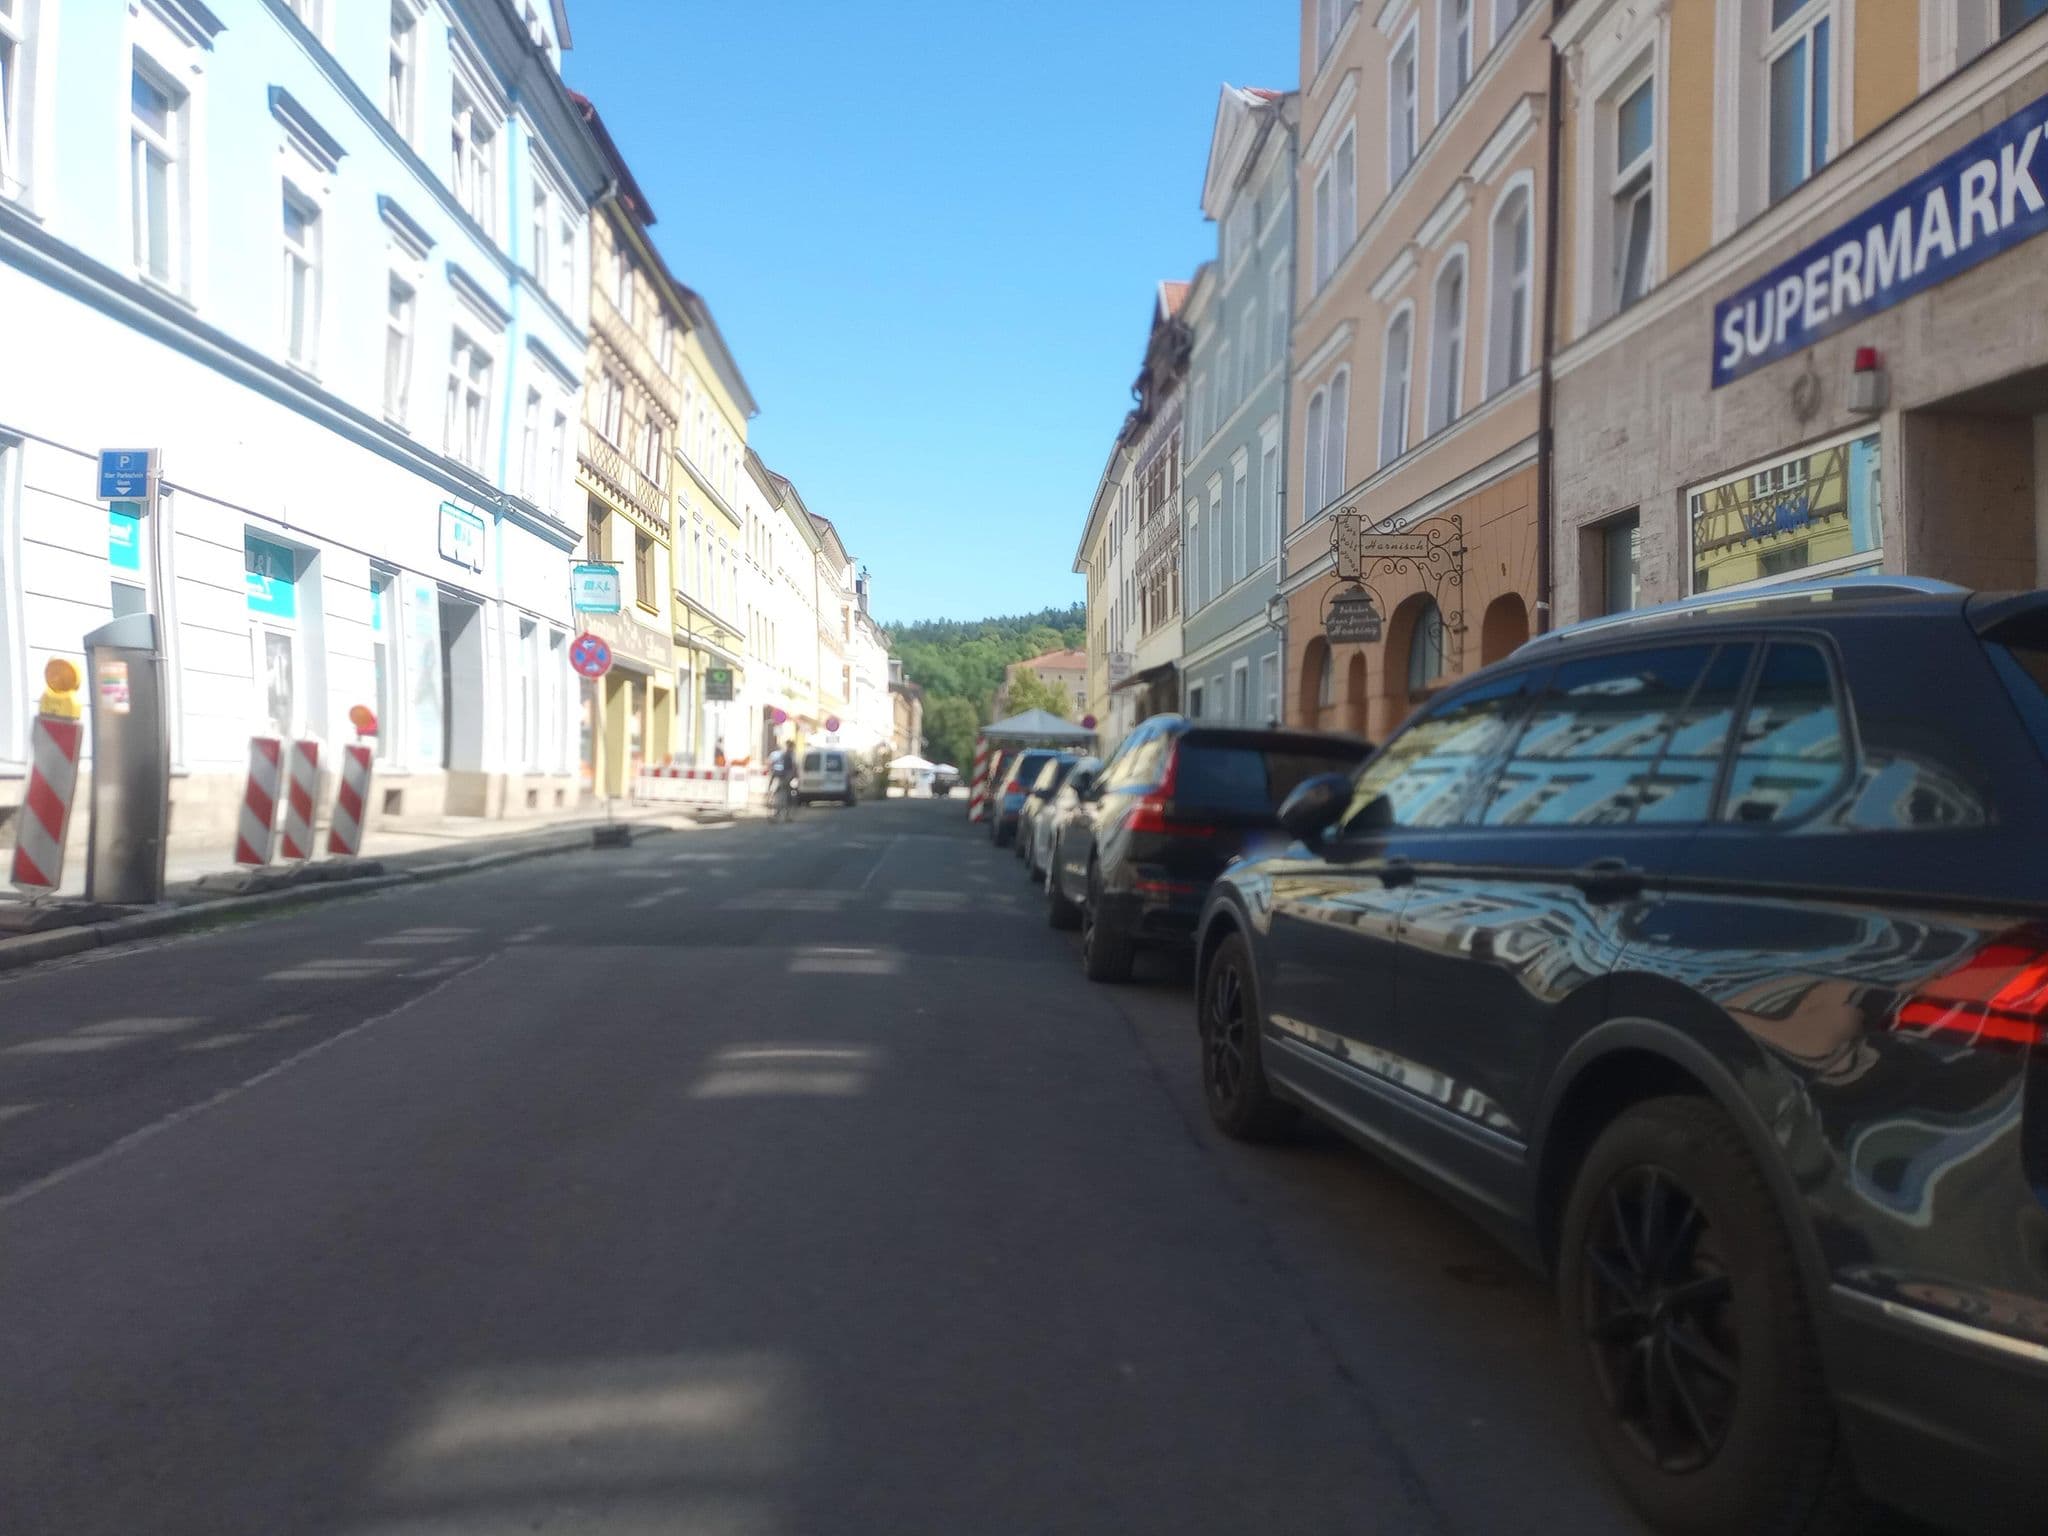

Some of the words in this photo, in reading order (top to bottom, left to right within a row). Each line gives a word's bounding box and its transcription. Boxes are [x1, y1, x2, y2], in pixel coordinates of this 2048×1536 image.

[1721, 122, 2048, 370] SUPERMARK
[120, 456, 130, 468] P
[1365, 540, 1423, 551] Harnisch
